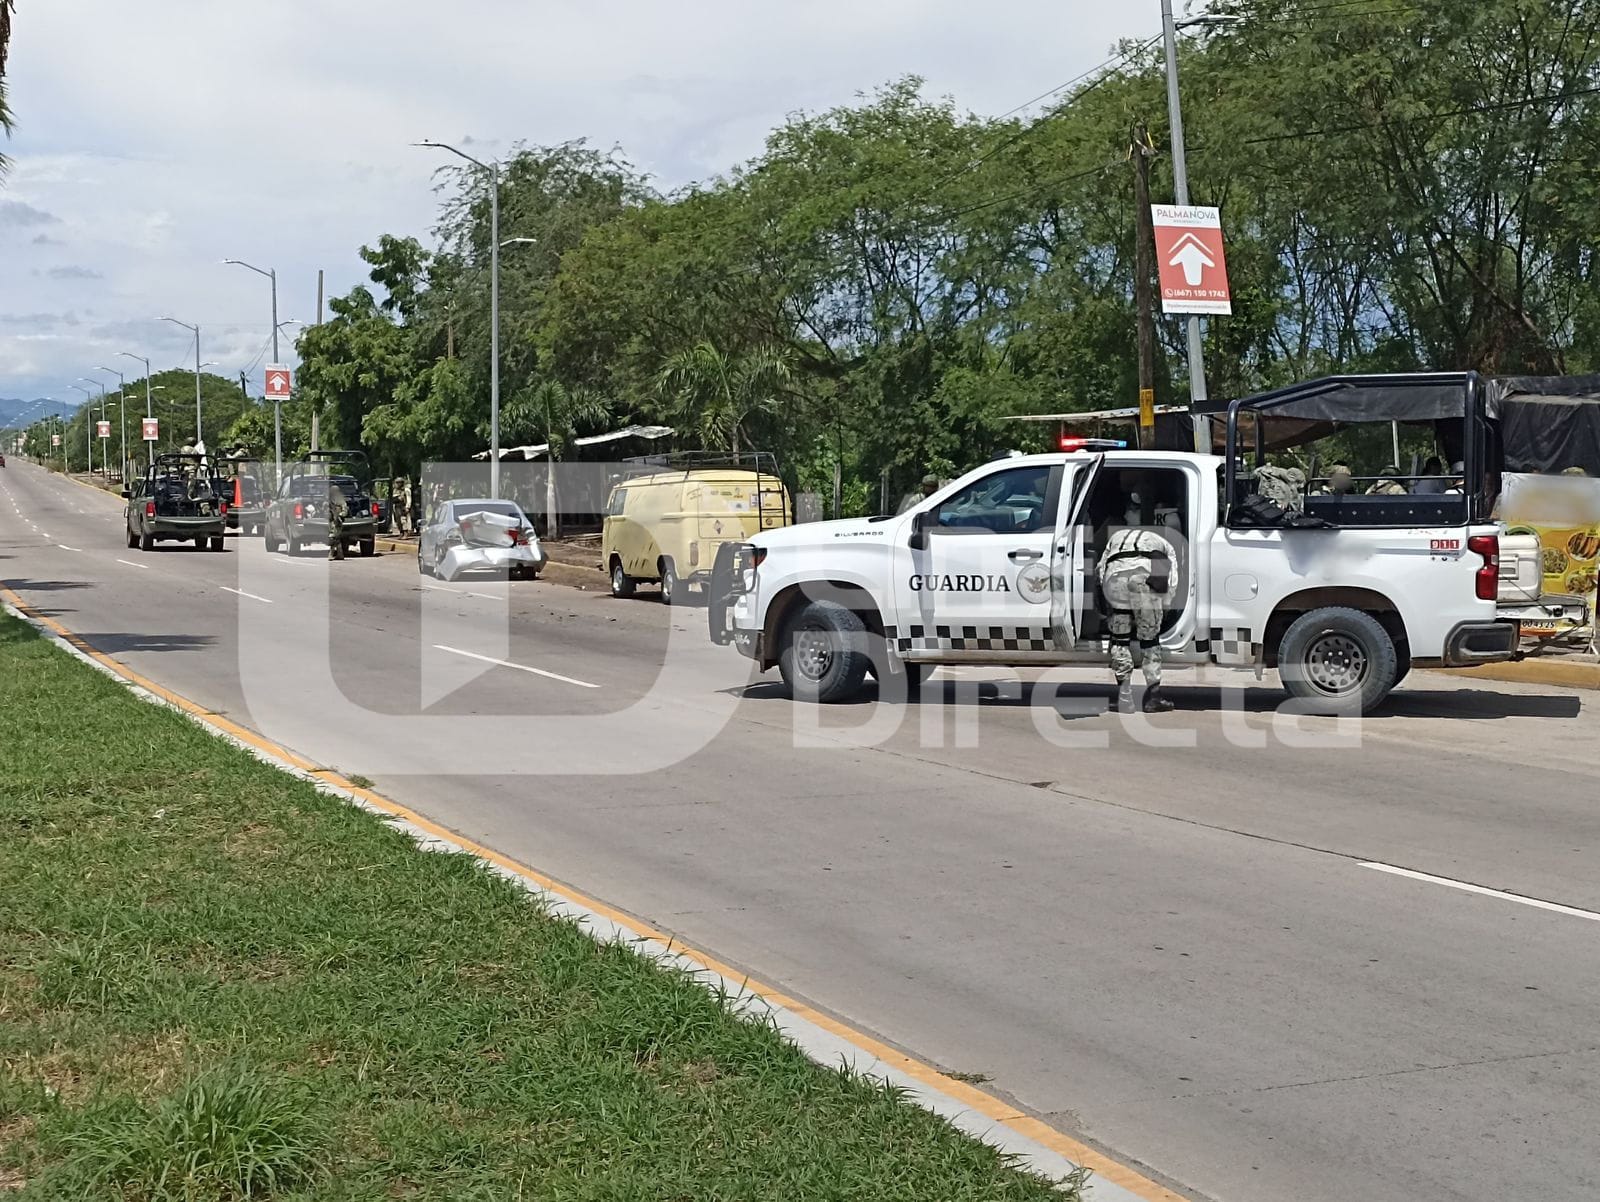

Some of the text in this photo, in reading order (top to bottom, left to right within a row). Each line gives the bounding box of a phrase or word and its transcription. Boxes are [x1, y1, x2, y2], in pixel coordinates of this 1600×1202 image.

[1156, 208, 1217, 220] PALMANOVA
[1431, 540, 1459, 549] 911
[908, 574, 1010, 592] GUARDIA
